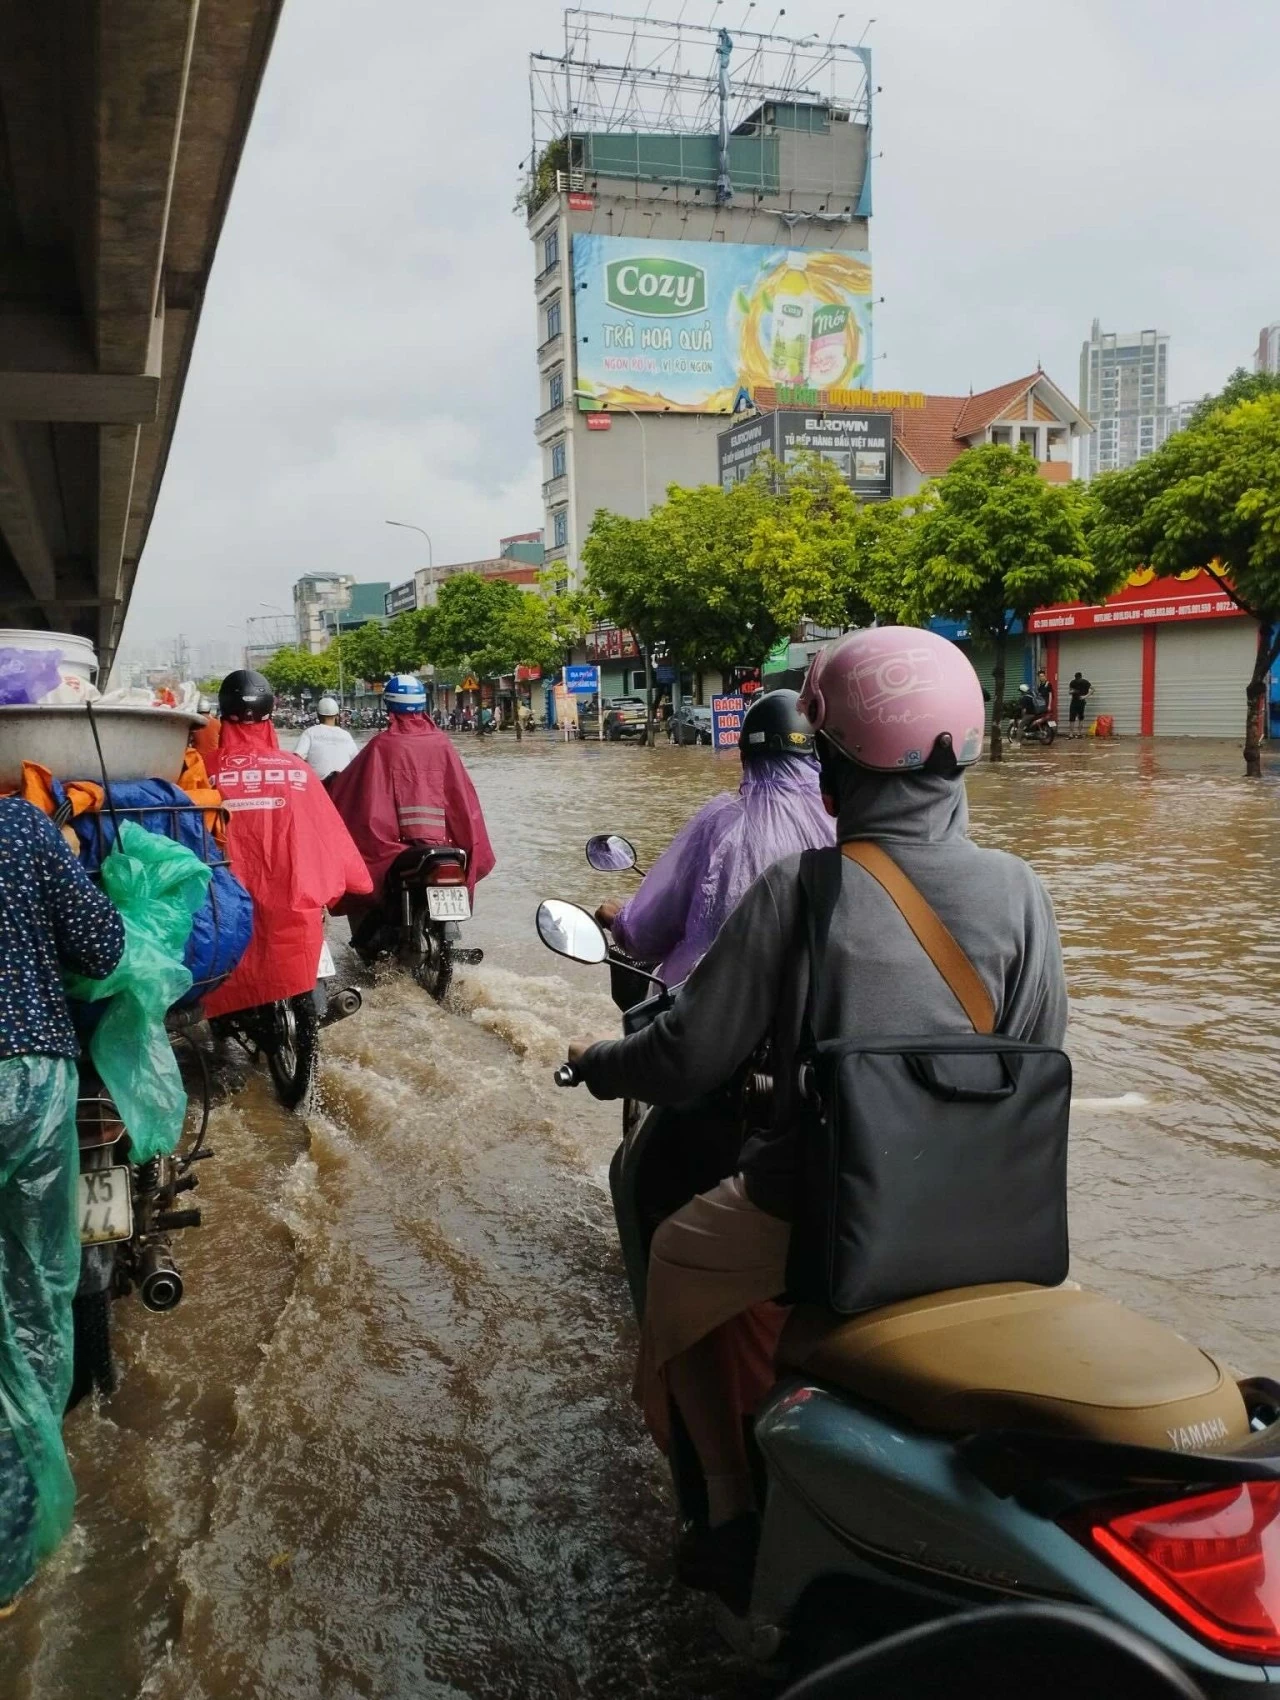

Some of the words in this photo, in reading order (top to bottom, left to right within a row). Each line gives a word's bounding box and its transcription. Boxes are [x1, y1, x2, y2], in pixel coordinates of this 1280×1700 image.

[616, 266, 695, 307] Cozy
[814, 309, 846, 334] Mới
[603, 320, 634, 348] TRÀ
[641, 328, 672, 350] HOA
[679, 320, 713, 351] QUẢ
[604, 358, 628, 371] NGON
[690, 360, 713, 373] NGON
[805, 419, 869, 432] EUROWIN
[731, 425, 762, 447] EUROWIN
[796, 433, 811, 446] BẾP
[851, 436, 866, 449] VIỆT
[868, 438, 885, 448] NAM
[714, 697, 743, 711] BÁCH
[718, 714, 741, 728] HÓA
[719, 730, 741, 745] SƠN
[1166, 1418, 1229, 1448] YAMAHA
